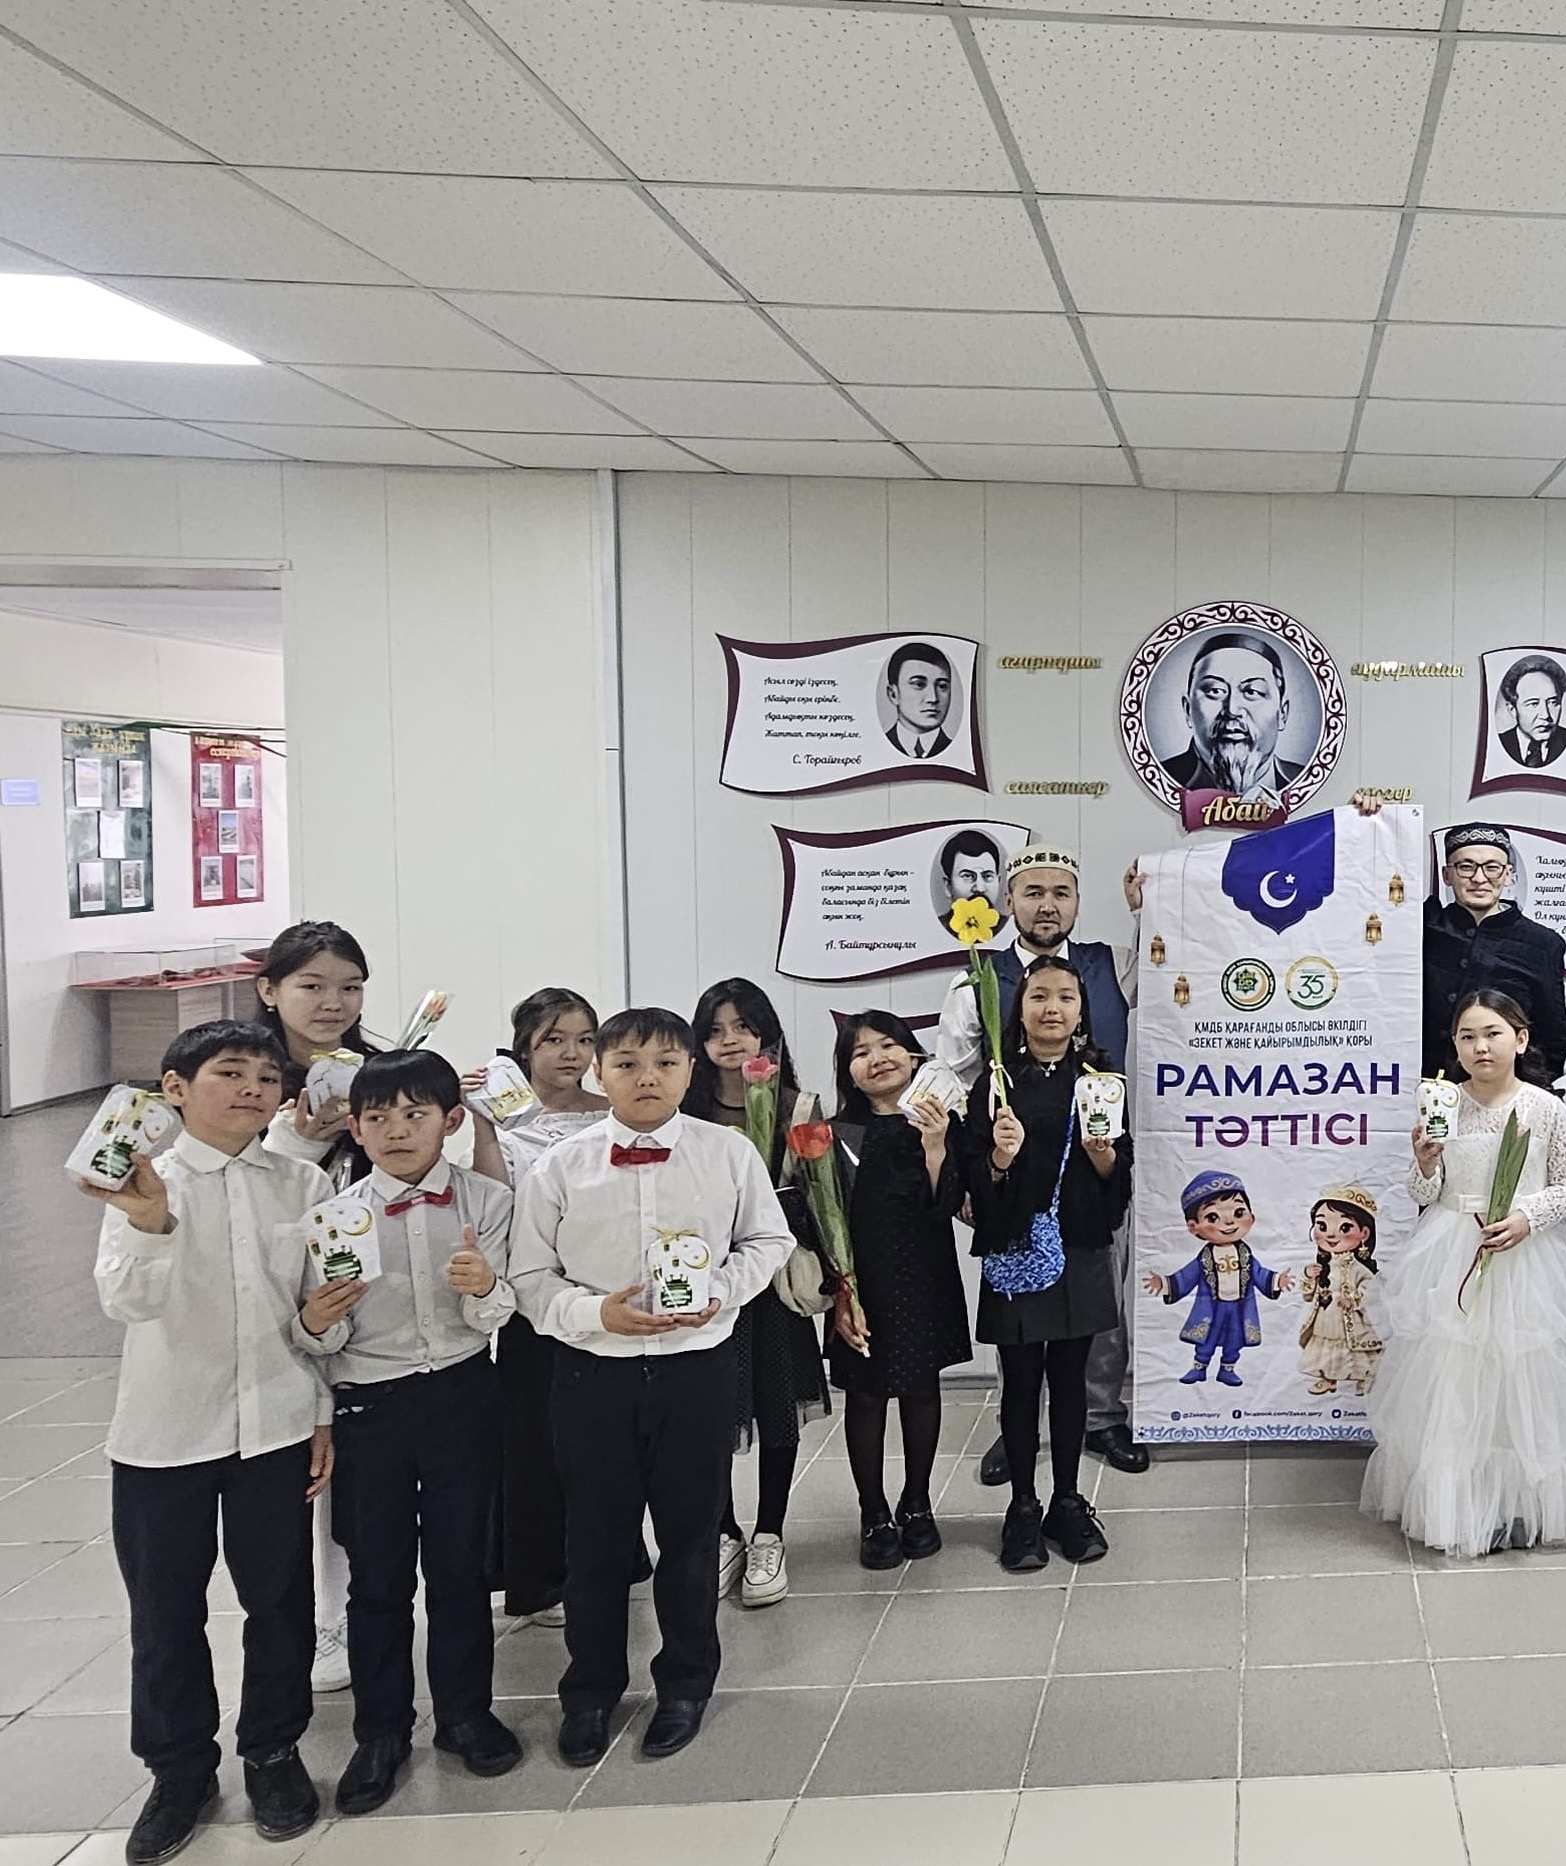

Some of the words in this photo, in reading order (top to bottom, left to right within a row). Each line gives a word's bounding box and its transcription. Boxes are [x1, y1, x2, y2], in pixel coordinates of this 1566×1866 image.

[792, 754, 802, 764] С.
[1201, 796, 1274, 825] Абай
[1536, 855, 1566, 867] Халық
[1534, 884, 1566, 895] күшті
[1534, 911, 1547, 920] Ол
[825, 939, 837, 950] А.
[838, 939, 917, 951] Байтұрсынұлы
[1297, 974, 1326, 999] 35
[1194, 1021, 1223, 1034] ҚМДБ
[1225, 1020, 1284, 1035] ҚАРАҒАНДЫ
[1285, 1020, 1326, 1033] ОБЛЫСЫ
[1328, 1019, 1367, 1033] ӨКІЛДІГІ
[1225, 1036, 1252, 1049] ЖӘНЕ
[1253, 1034, 1344, 1050] ҚАЙЫРЫМДЫЛЫҚ»
[1346, 1035, 1373, 1048] ҚОРЫ
[1156, 1062, 1400, 1097] РАМАЗАН
[1185, 1113, 1368, 1148] ТӘТТІСІ
